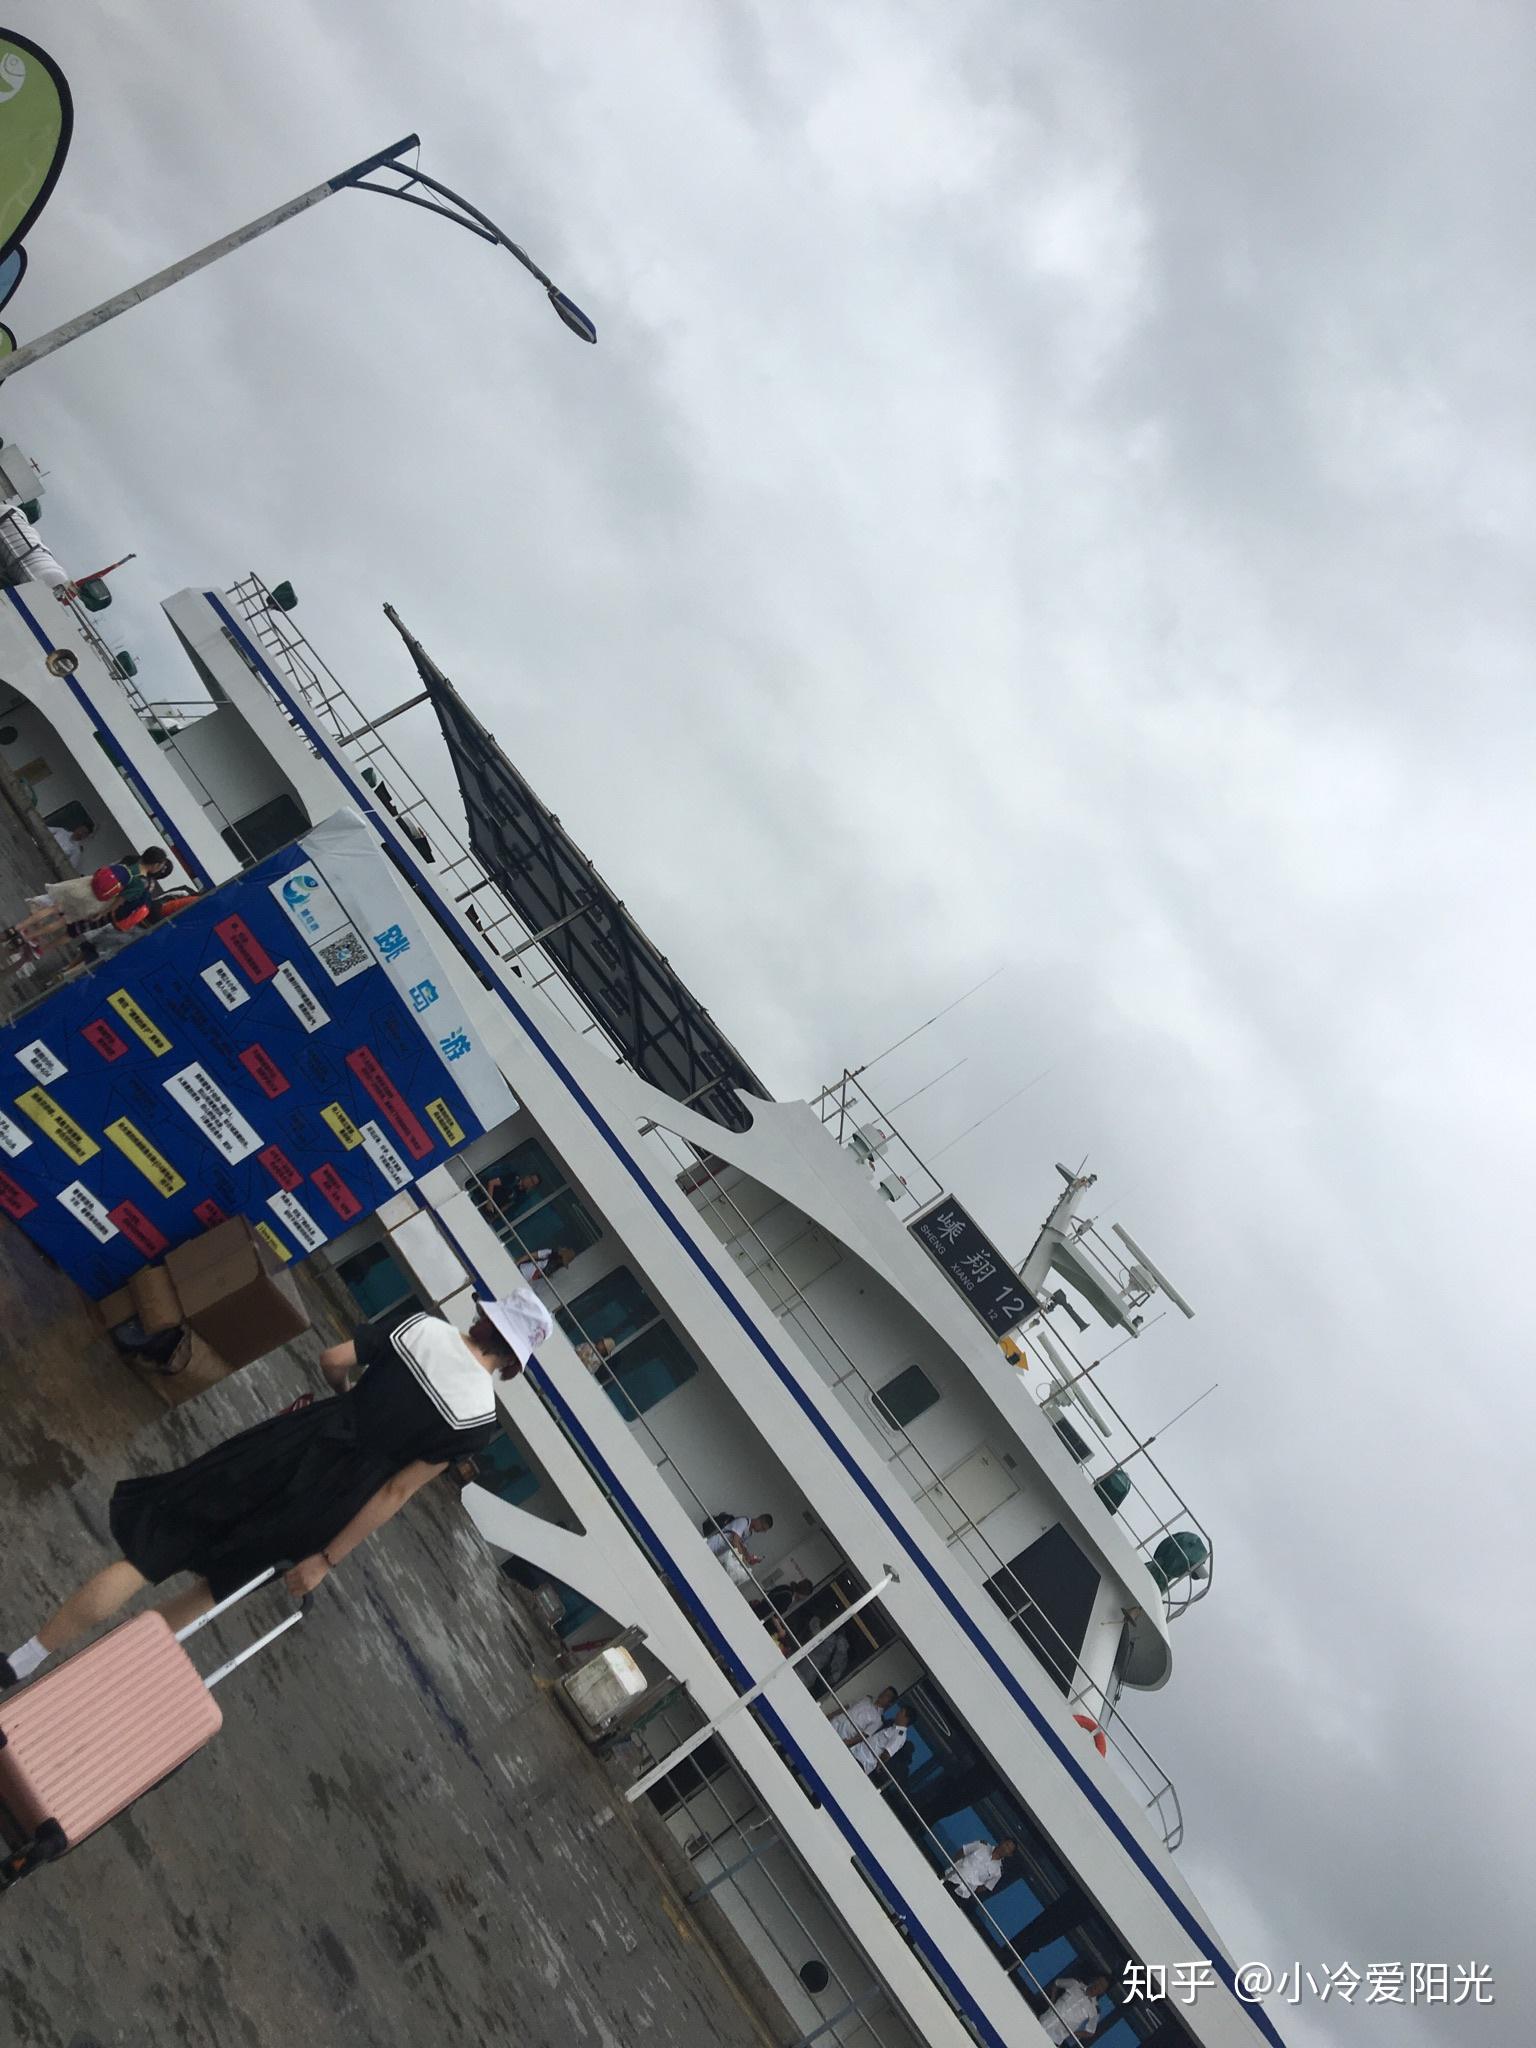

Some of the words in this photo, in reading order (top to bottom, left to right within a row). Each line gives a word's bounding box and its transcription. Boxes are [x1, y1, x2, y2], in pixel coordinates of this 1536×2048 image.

[373, 924, 472, 1062] 跳岛游
[920, 1224, 946, 1256] SHENG
[949, 1263, 975, 1292] XIANG
[987, 1308, 998, 1320] 12
